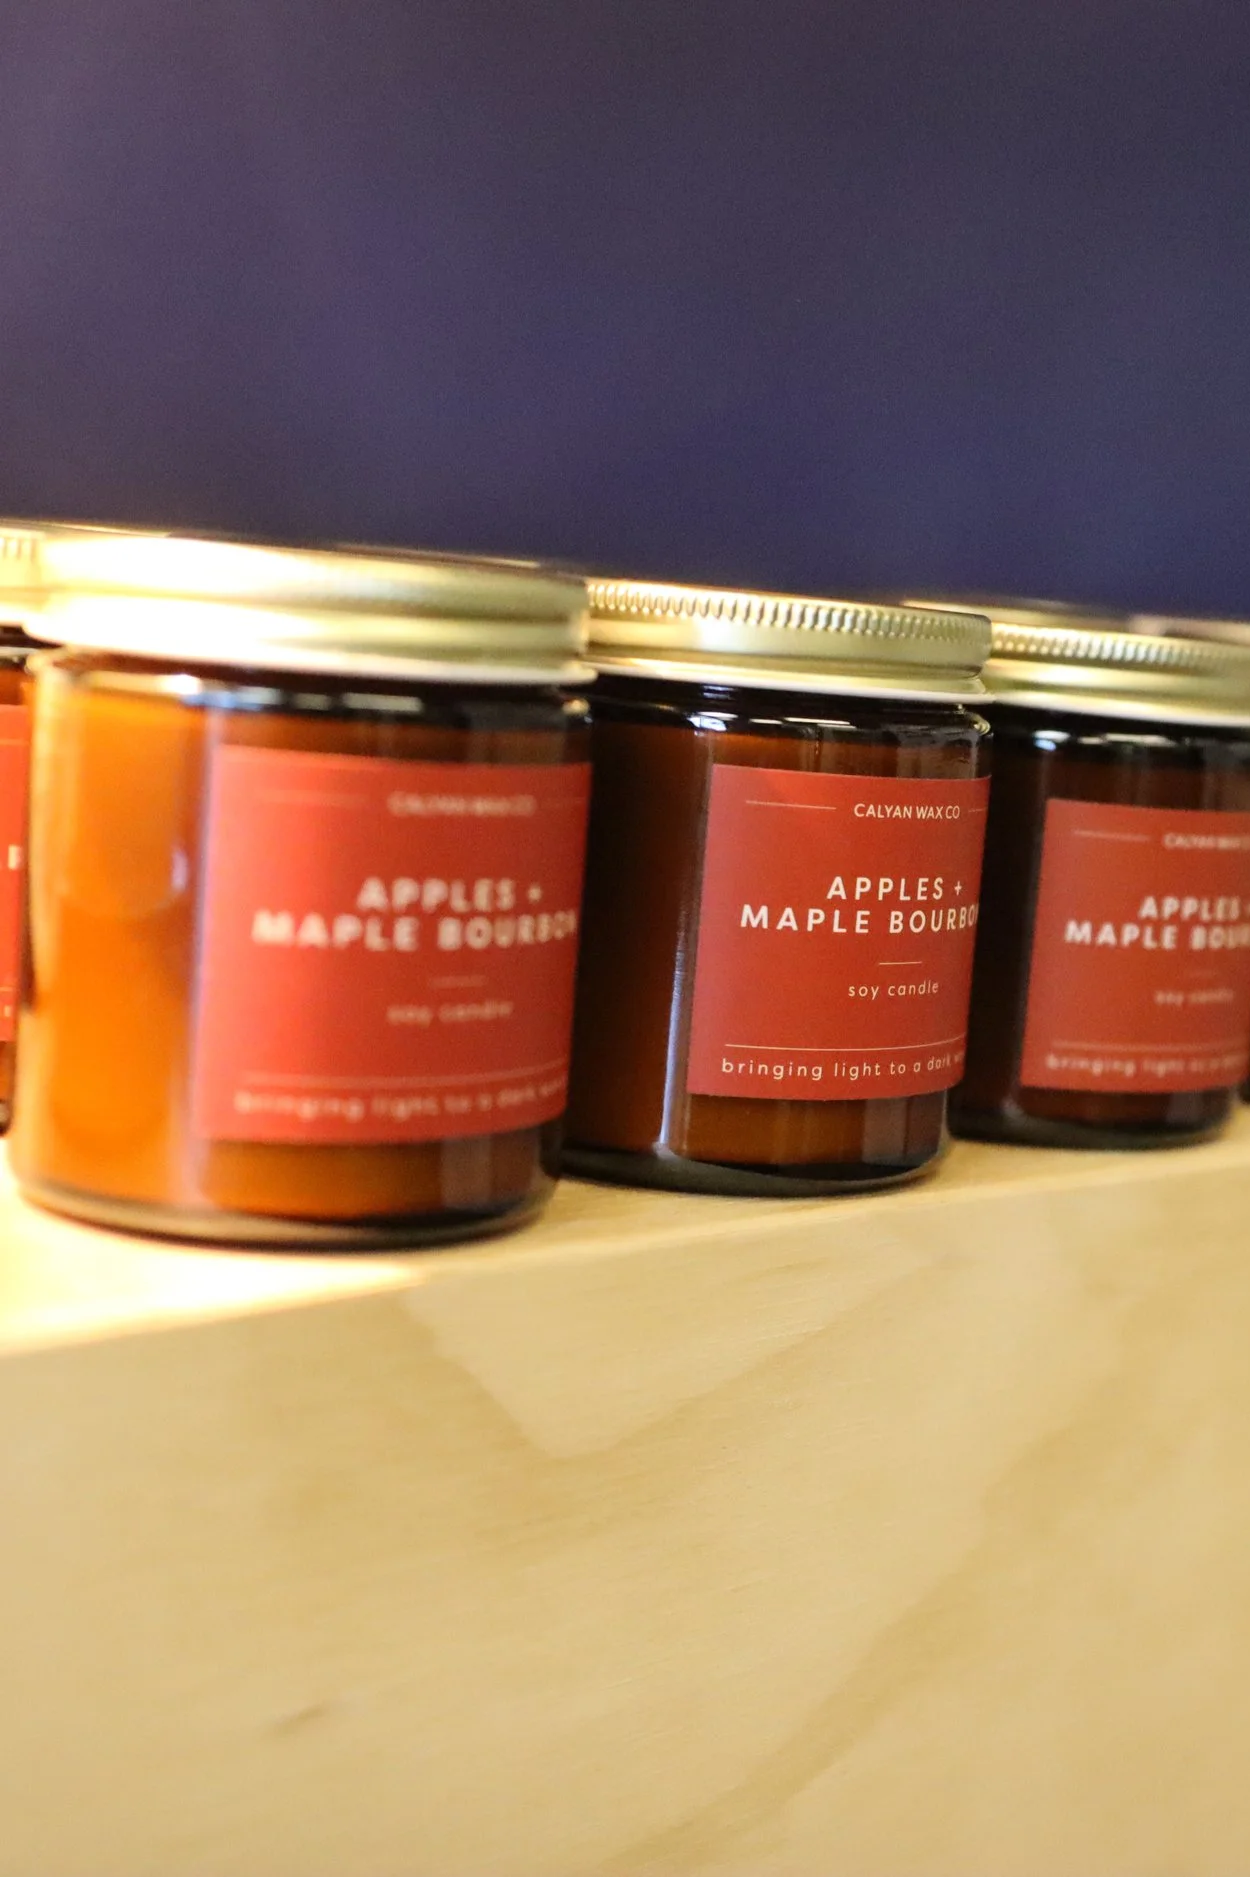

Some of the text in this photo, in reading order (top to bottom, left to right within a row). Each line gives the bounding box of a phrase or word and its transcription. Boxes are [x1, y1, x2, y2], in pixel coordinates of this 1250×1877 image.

[853, 803, 960, 819] CALYAN WAX CO
[357, 877, 515, 912] APPLES
[826, 876, 944, 901] APPLES
[252, 910, 419, 951] MAPLE
[739, 904, 870, 934] MAPLE
[1064, 919, 1178, 950] MAPLE
[848, 980, 939, 999] soy candle
[721, 1058, 823, 1080] bringing
[834, 1061, 881, 1080] light
[890, 1060, 906, 1075] to
[913, 1062, 921, 1073] a
